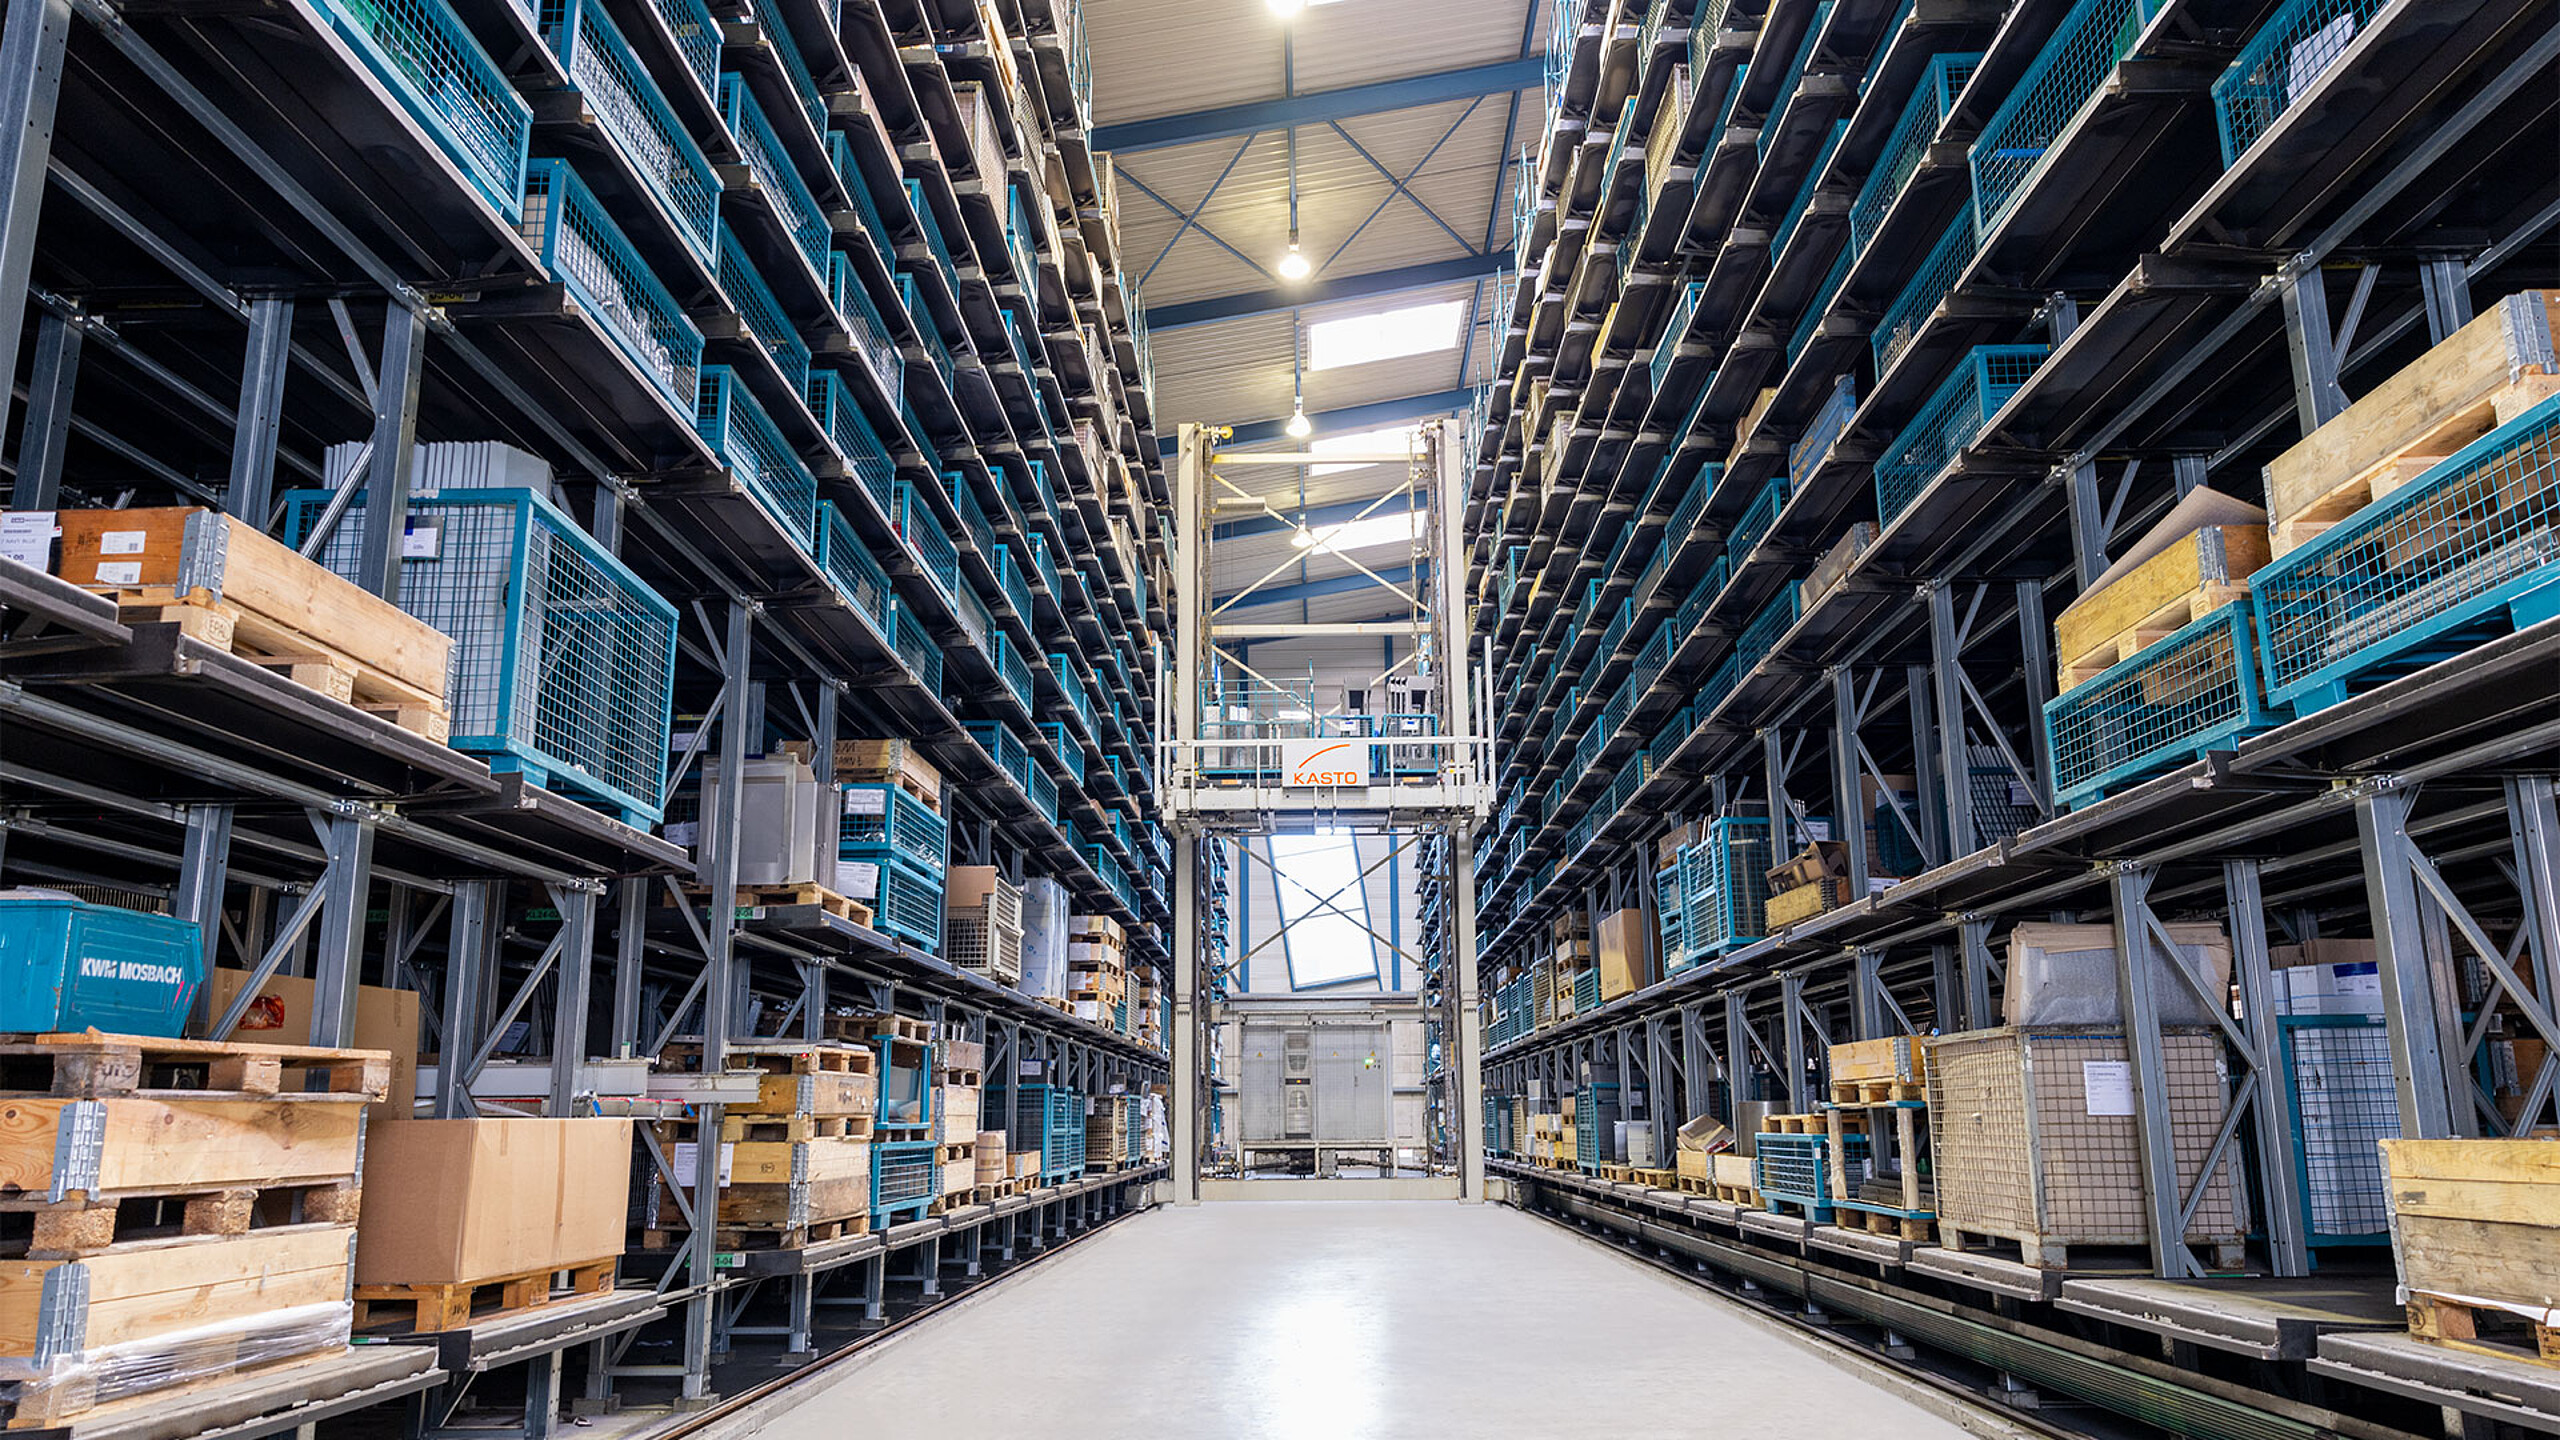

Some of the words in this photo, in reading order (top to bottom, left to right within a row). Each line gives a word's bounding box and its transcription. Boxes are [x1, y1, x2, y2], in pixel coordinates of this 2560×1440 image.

[1293, 771, 1357, 785] KASTO
[81, 957, 118, 979] KWM
[119, 961, 182, 985] MOSBACH
